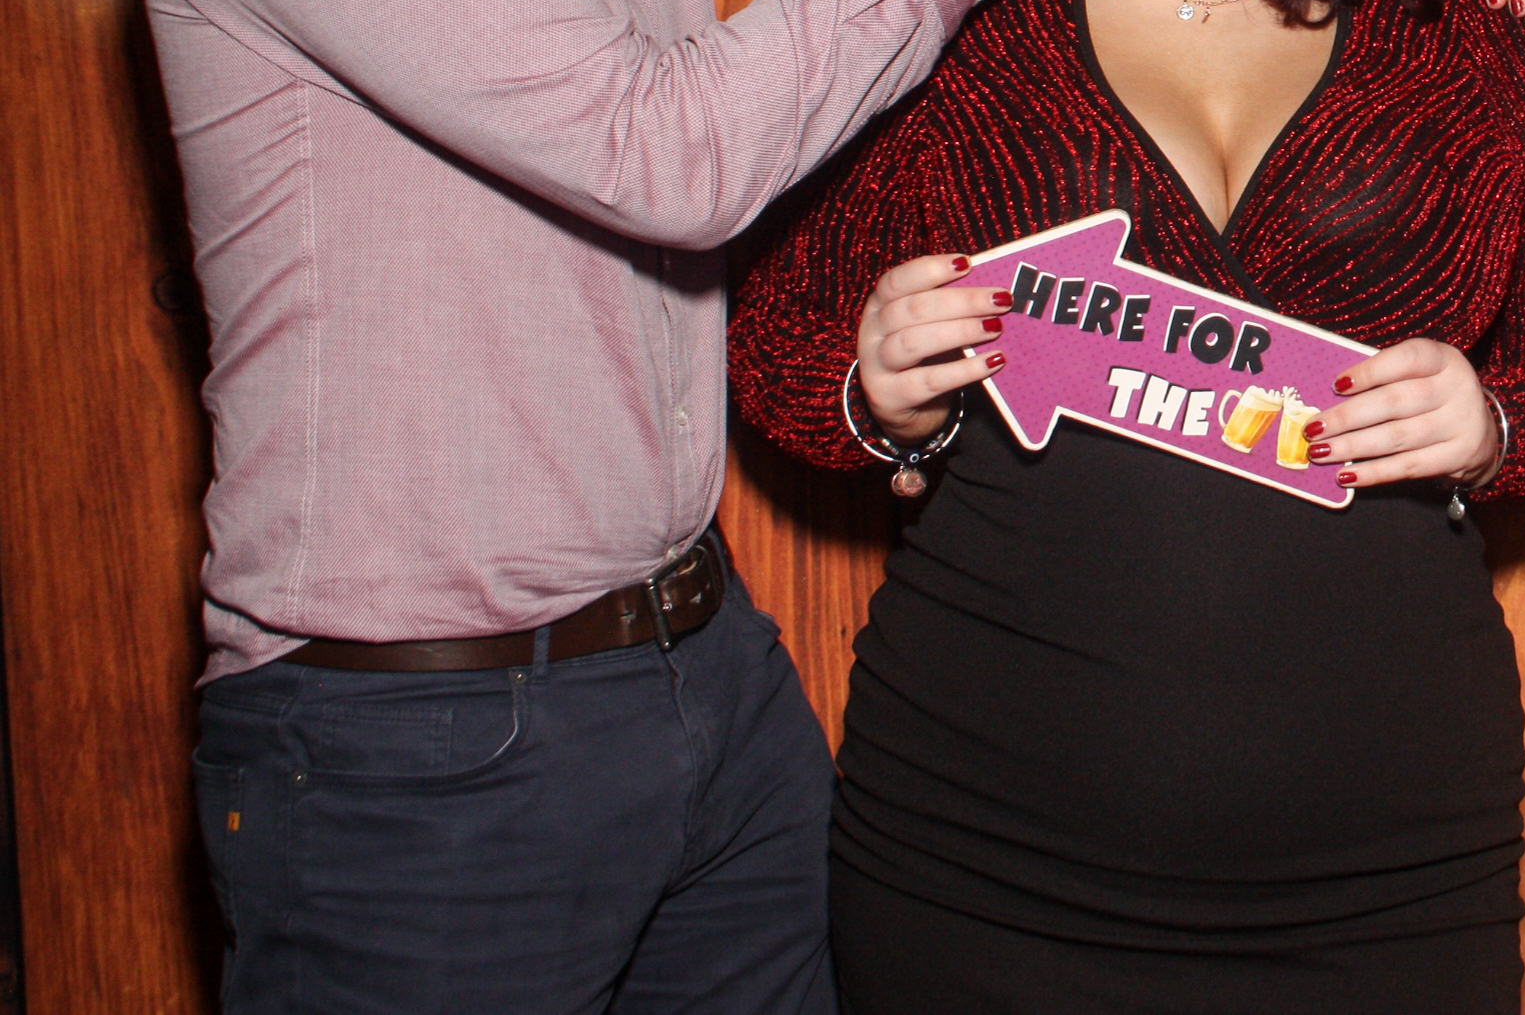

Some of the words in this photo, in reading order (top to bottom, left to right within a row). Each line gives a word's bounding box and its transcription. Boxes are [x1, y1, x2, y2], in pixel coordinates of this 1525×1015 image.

[1010, 261, 1151, 342] HERE
[1163, 305, 1272, 375] FOR
[1108, 366, 1216, 436] THE
